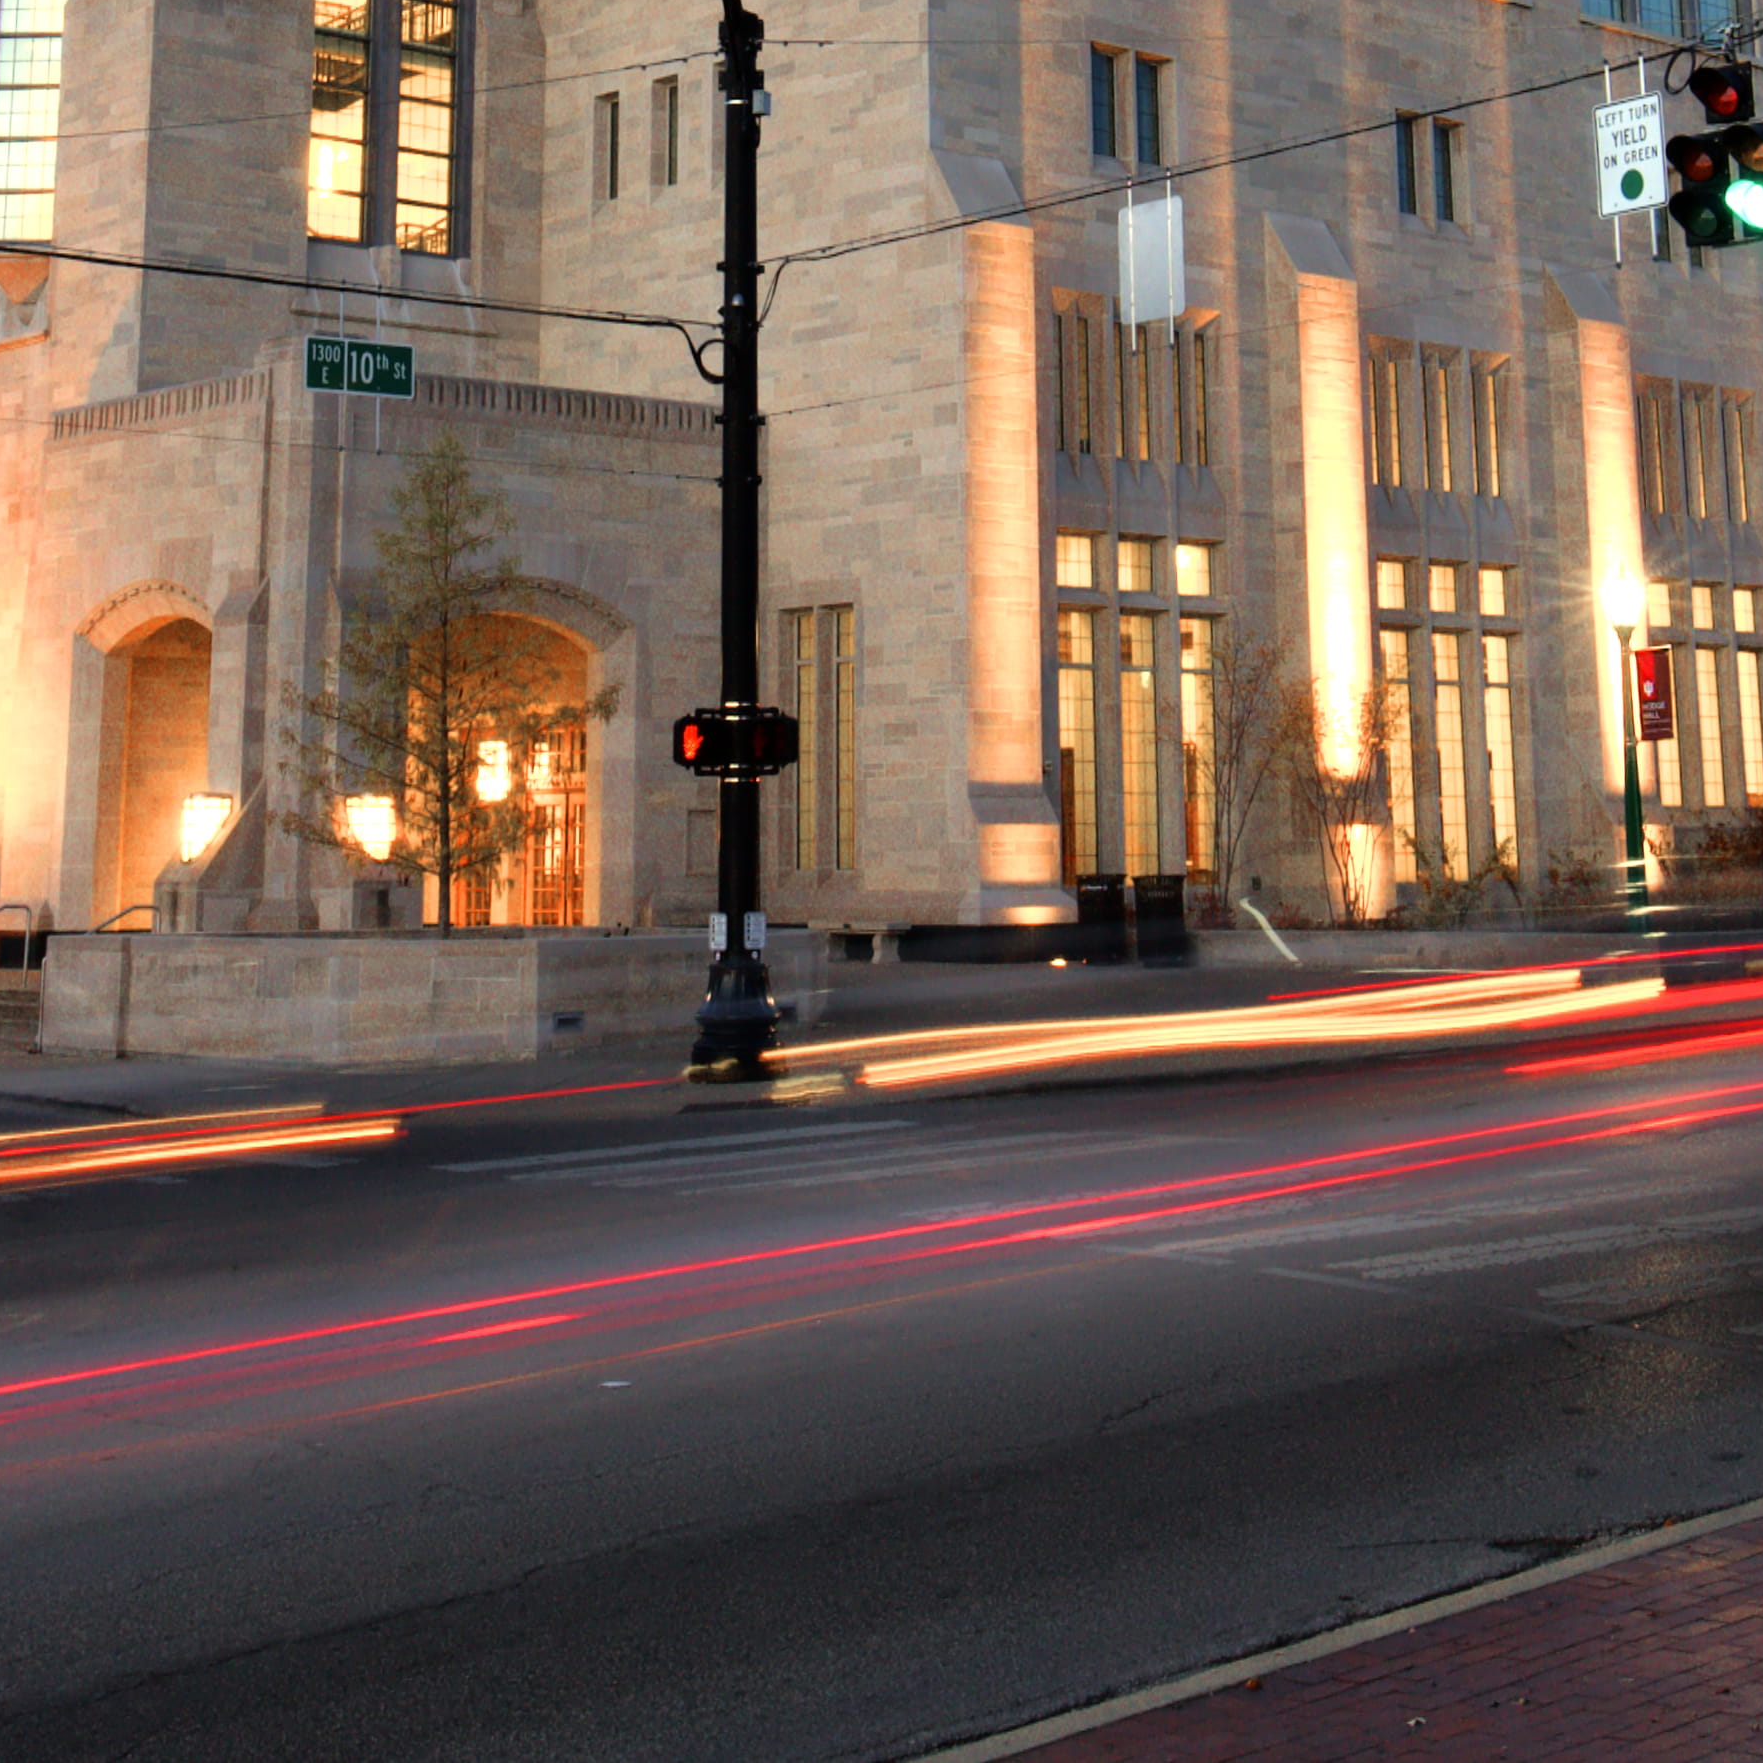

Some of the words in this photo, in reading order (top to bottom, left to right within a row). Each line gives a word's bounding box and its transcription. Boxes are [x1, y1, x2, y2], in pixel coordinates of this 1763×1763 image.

[1597, 109, 1624, 129] LEFT
[1629, 103, 1658, 123] TURN
[1611, 126, 1648, 148] YIELD
[1603, 155, 1618, 169] ON
[1624, 145, 1659, 165] GREEN
[311, 343, 341, 363] 1300
[321, 366, 329, 384] E
[349, 350, 389, 384] 10th
[393, 362, 406, 380] St
